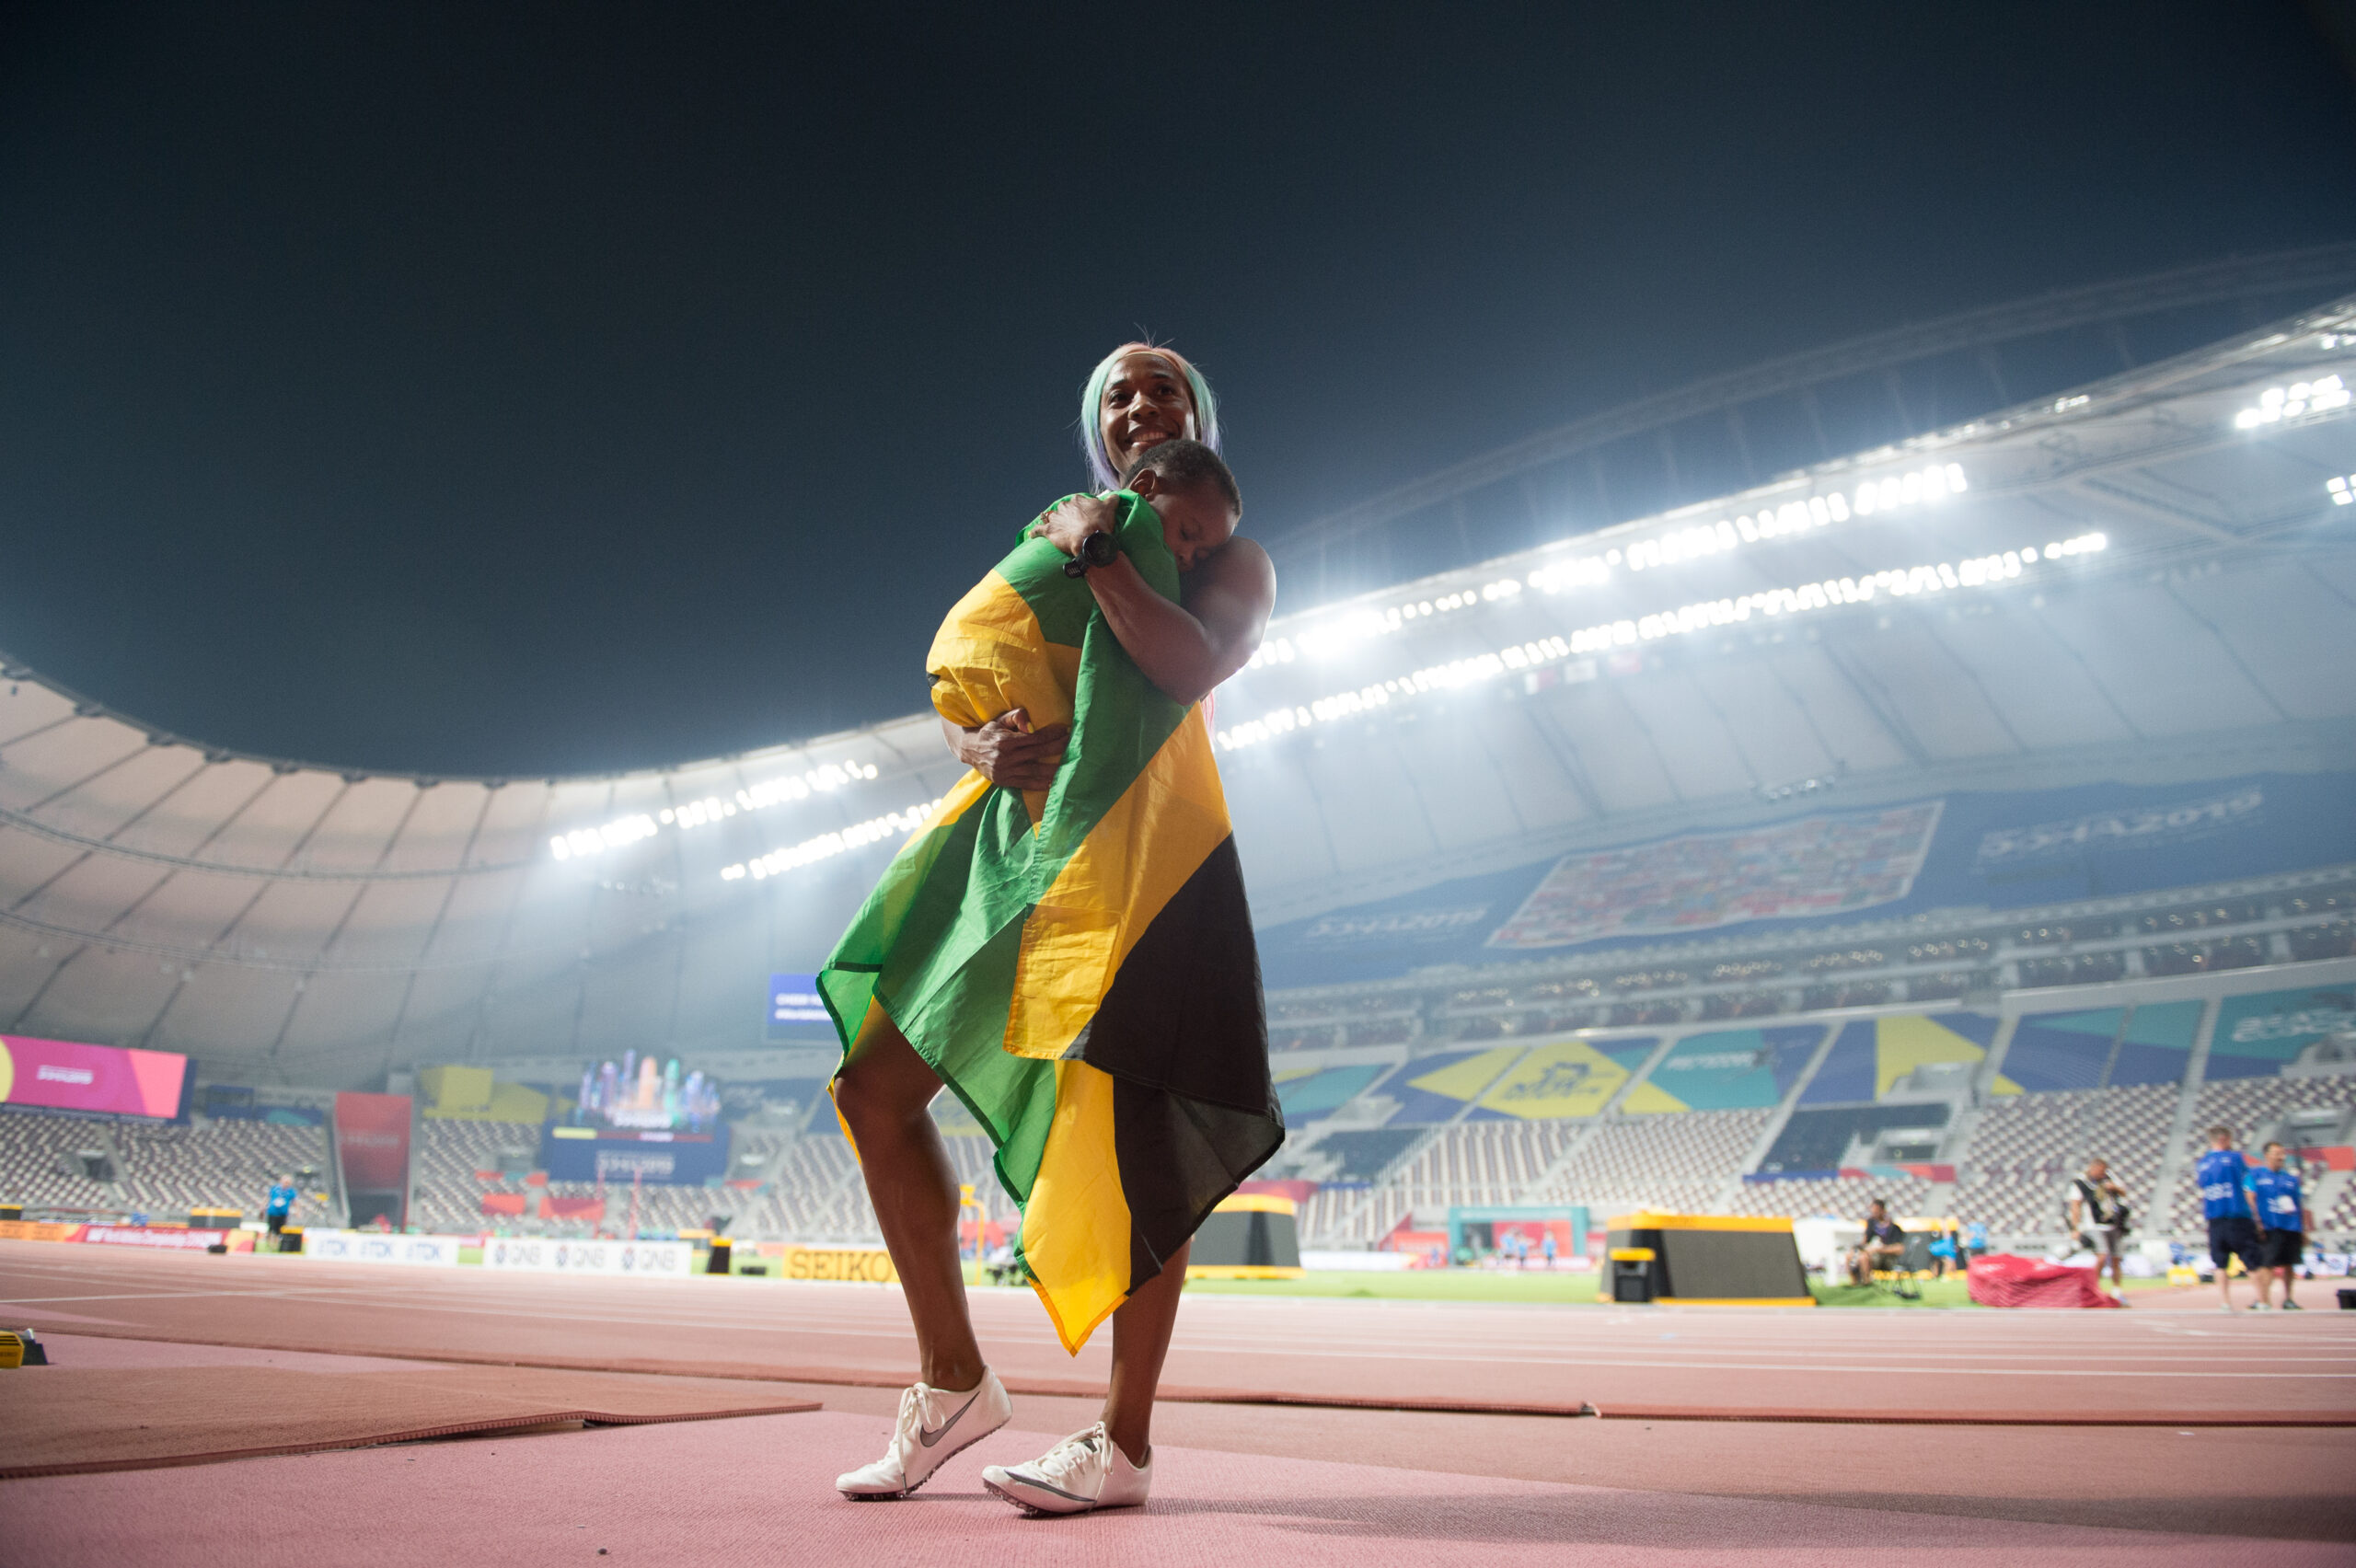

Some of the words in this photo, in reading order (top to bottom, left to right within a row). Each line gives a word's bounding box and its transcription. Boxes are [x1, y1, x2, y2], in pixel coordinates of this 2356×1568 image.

[509, 1244, 541, 1266] QNB
[571, 1246, 605, 1268] QNB
[639, 1249, 676, 1272] QNB
[791, 1251, 892, 1282] SEIKO
